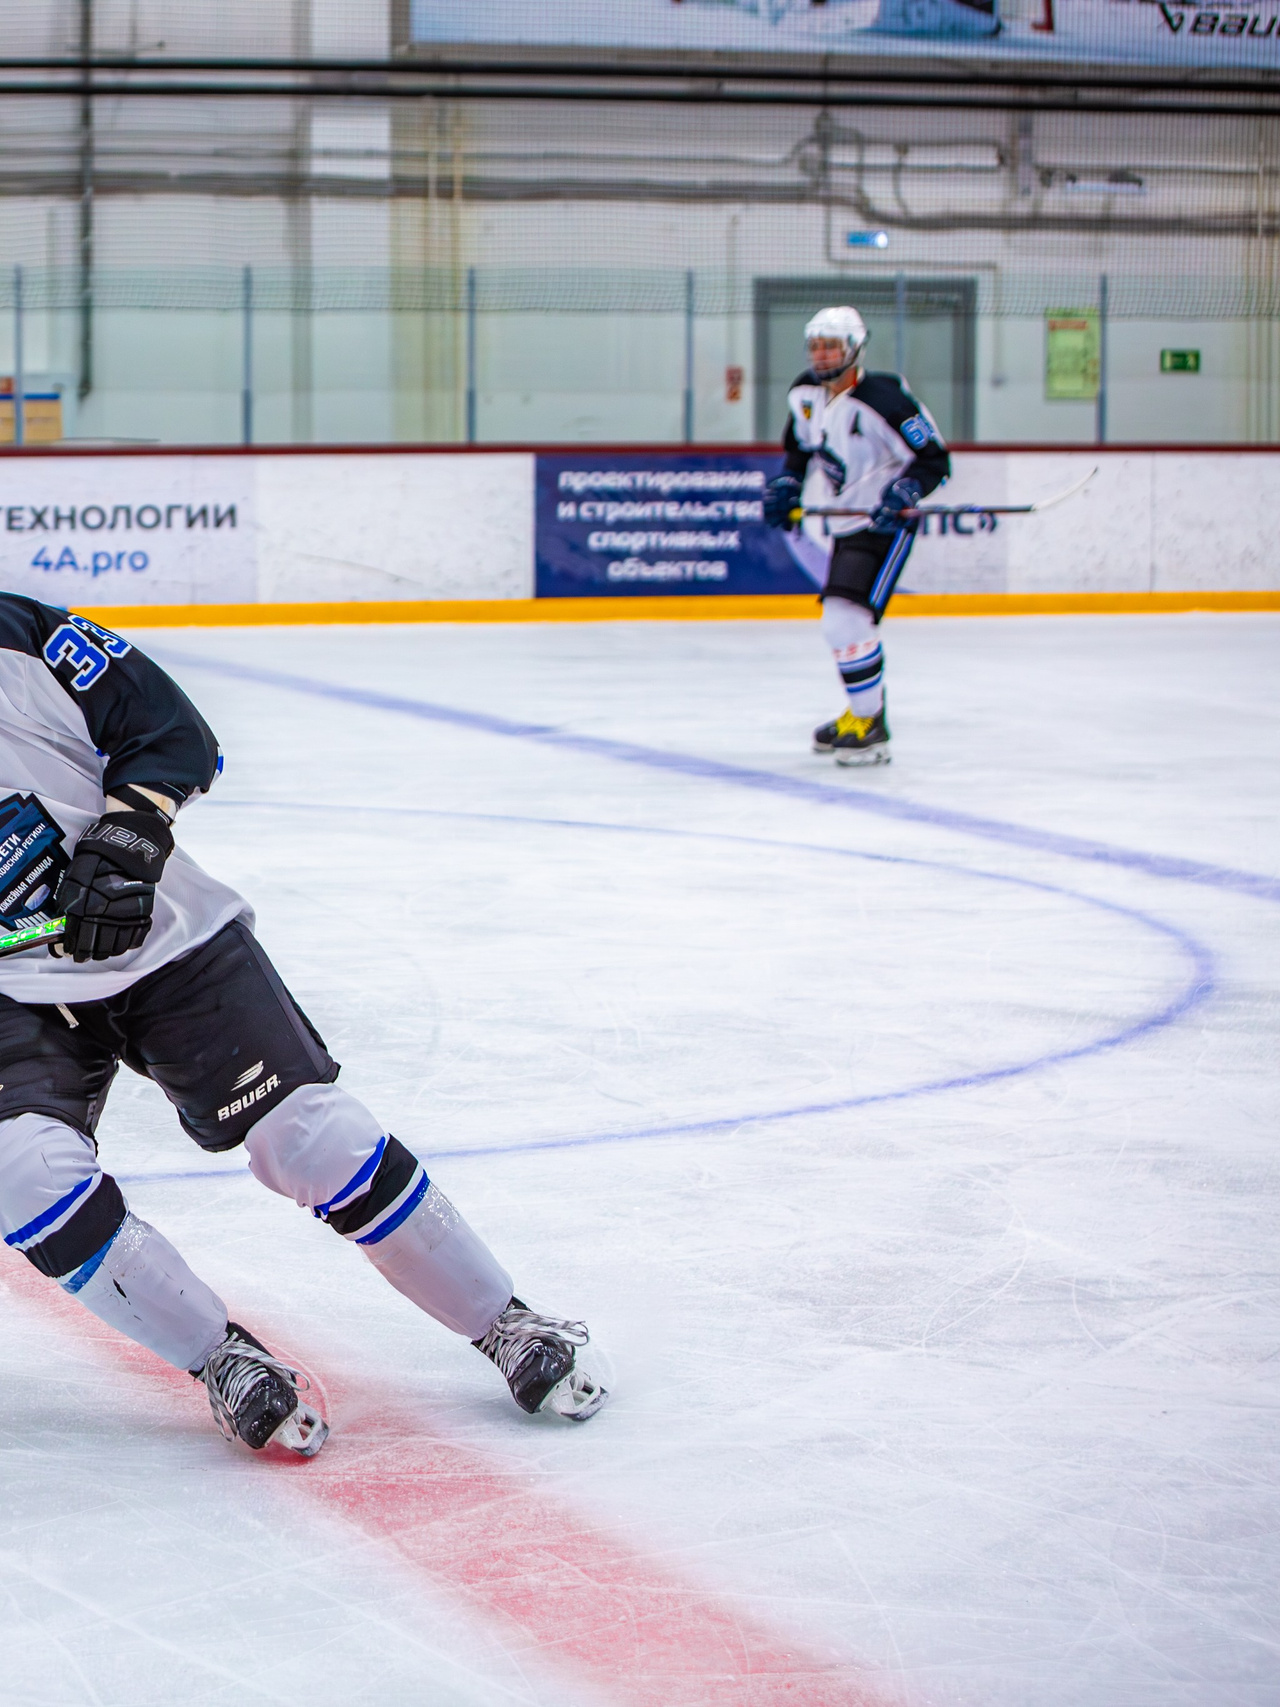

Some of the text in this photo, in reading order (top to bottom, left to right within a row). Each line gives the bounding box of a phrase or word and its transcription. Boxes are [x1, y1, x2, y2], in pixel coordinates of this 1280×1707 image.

[1190, 11, 1280, 36] BAU
[557, 470, 766, 496] проектирование
[557, 501, 577, 522] и
[587, 530, 741, 555] спортивных
[30, 546, 150, 577] 4A.pro
[606, 557, 728, 581] объектов
[42, 613, 133, 692] 33
[21, 823, 46, 850] РЕГИОН
[24, 855, 54, 885] КОМАНДА
